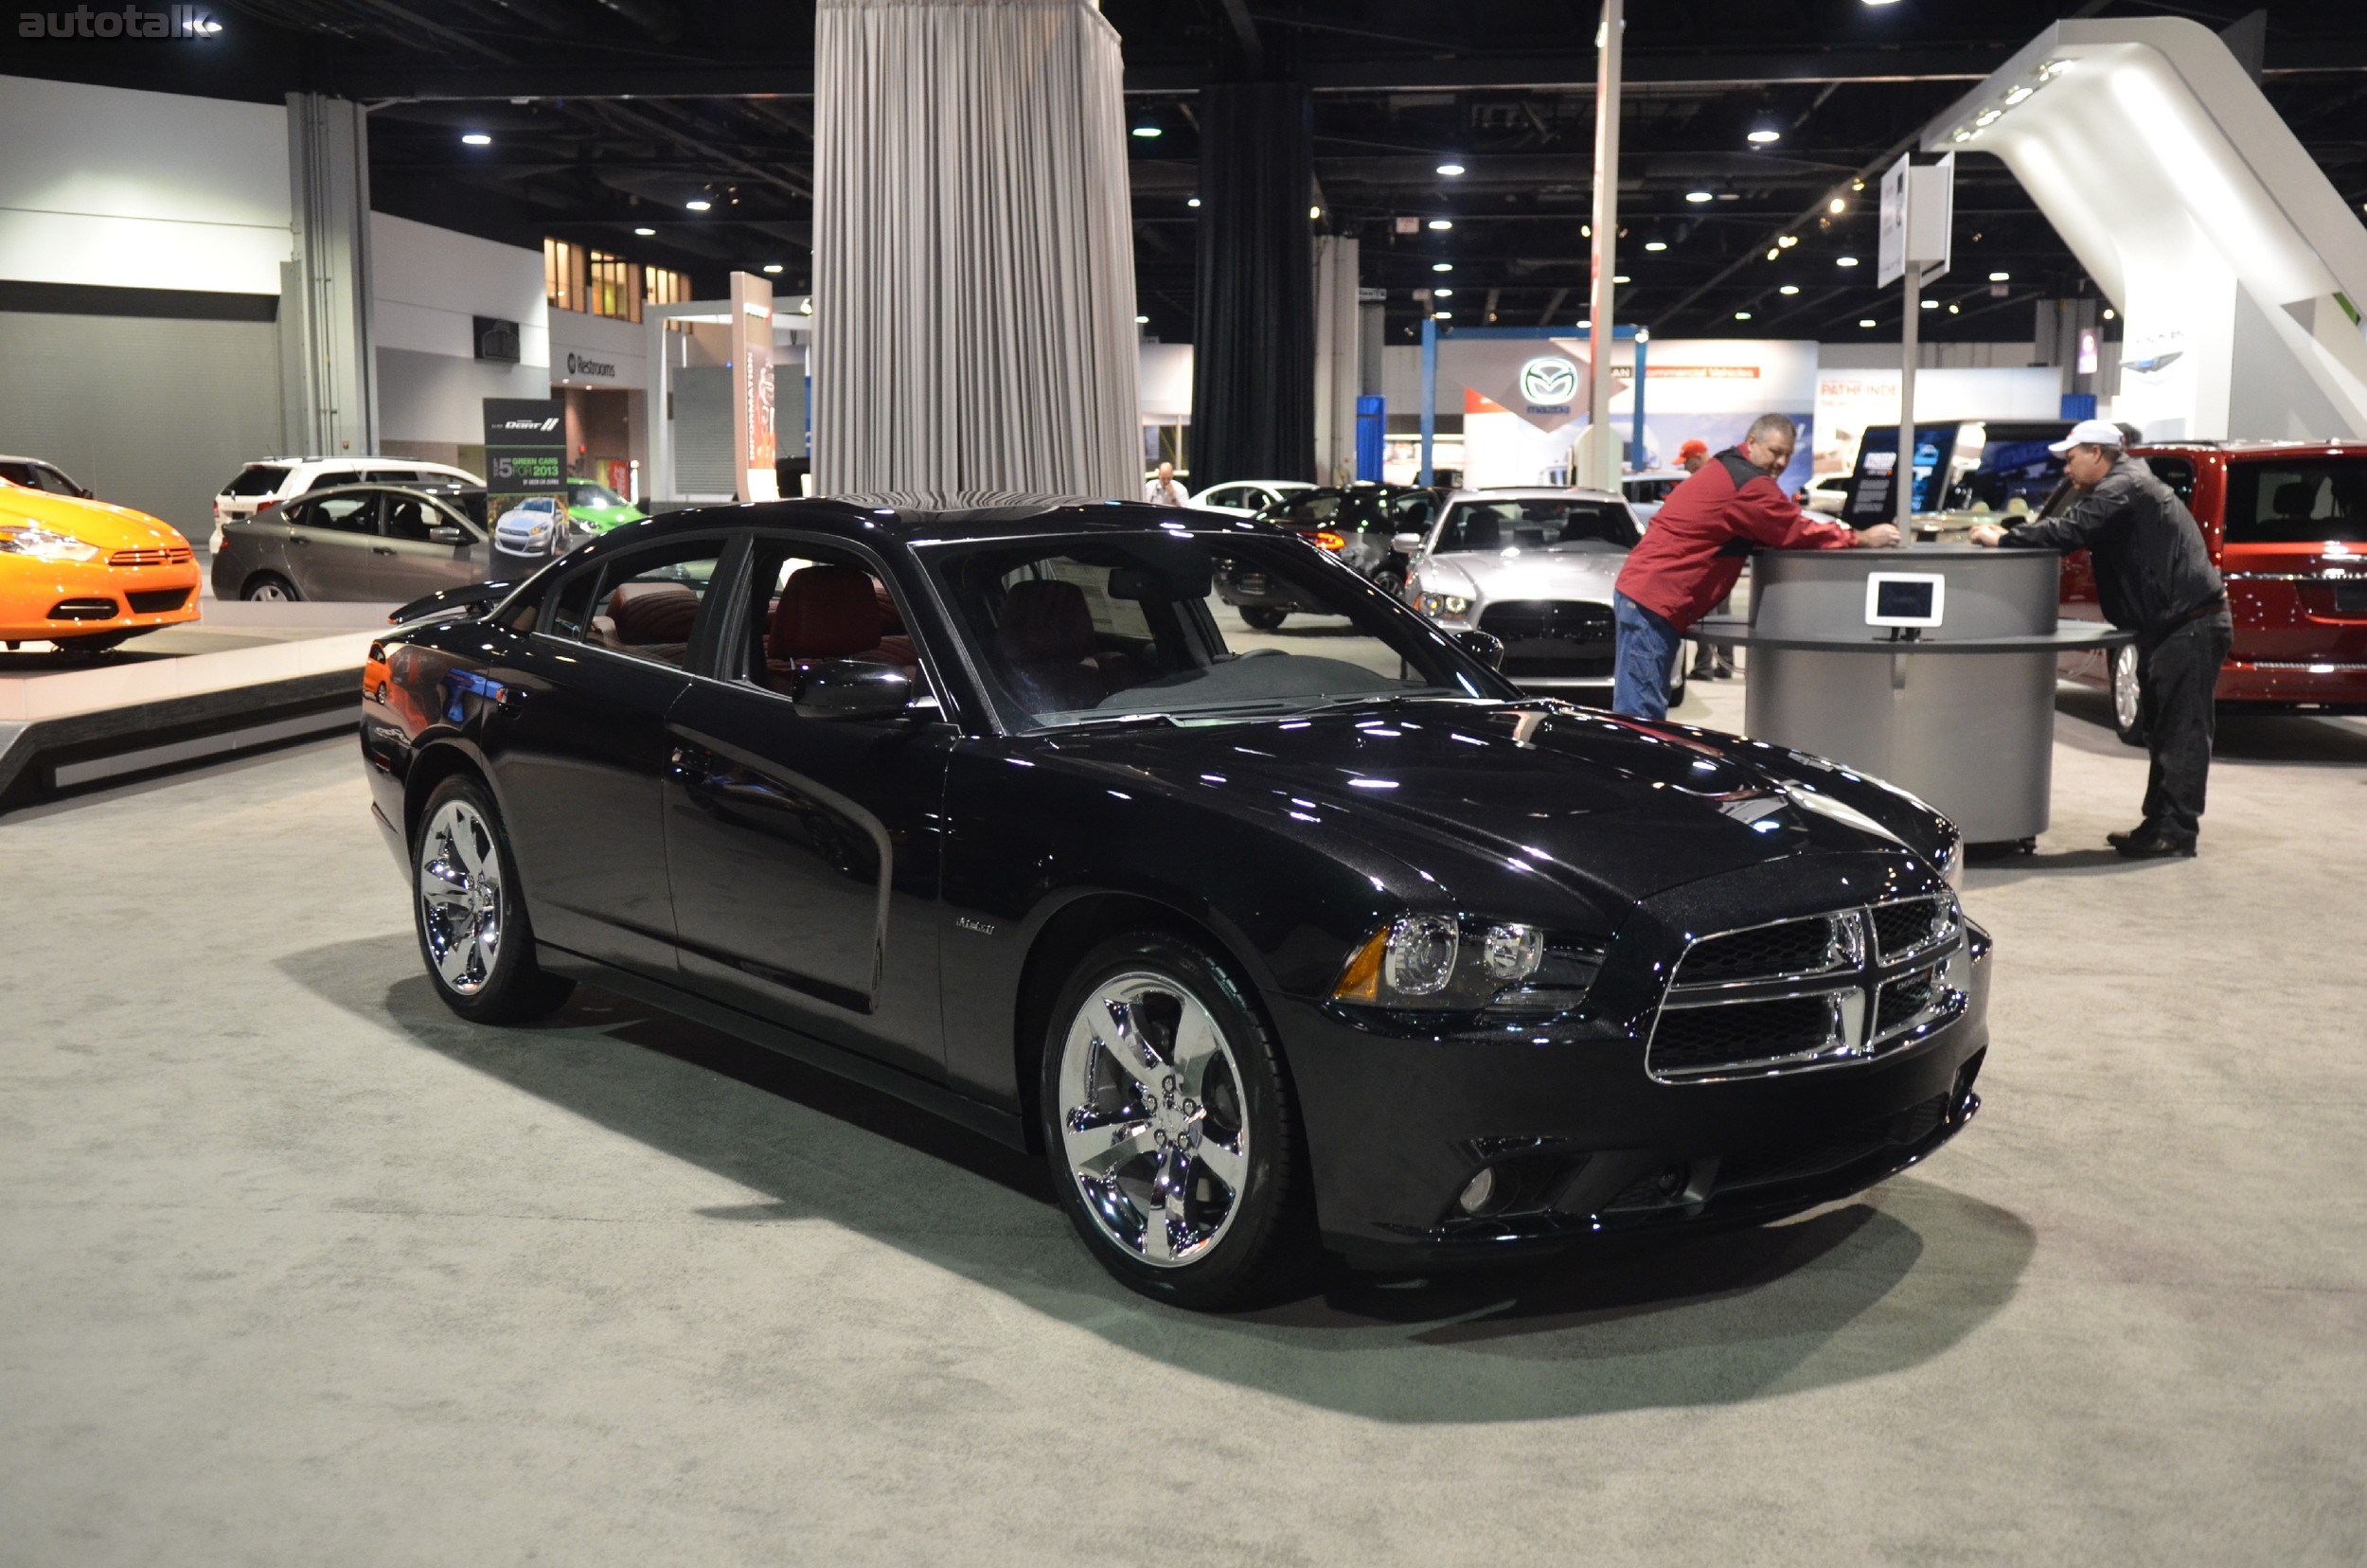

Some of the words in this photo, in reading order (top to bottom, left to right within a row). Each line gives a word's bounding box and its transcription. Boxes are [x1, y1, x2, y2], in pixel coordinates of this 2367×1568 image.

[578, 355, 615, 378] Restrooms
[1646, 365, 1707, 378] ommercial
[1821, 383, 1898, 396] PATHFINDE
[1526, 405, 1571, 415] mazda
[499, 457, 512, 478] 5
[533, 465, 560, 477] 2013
